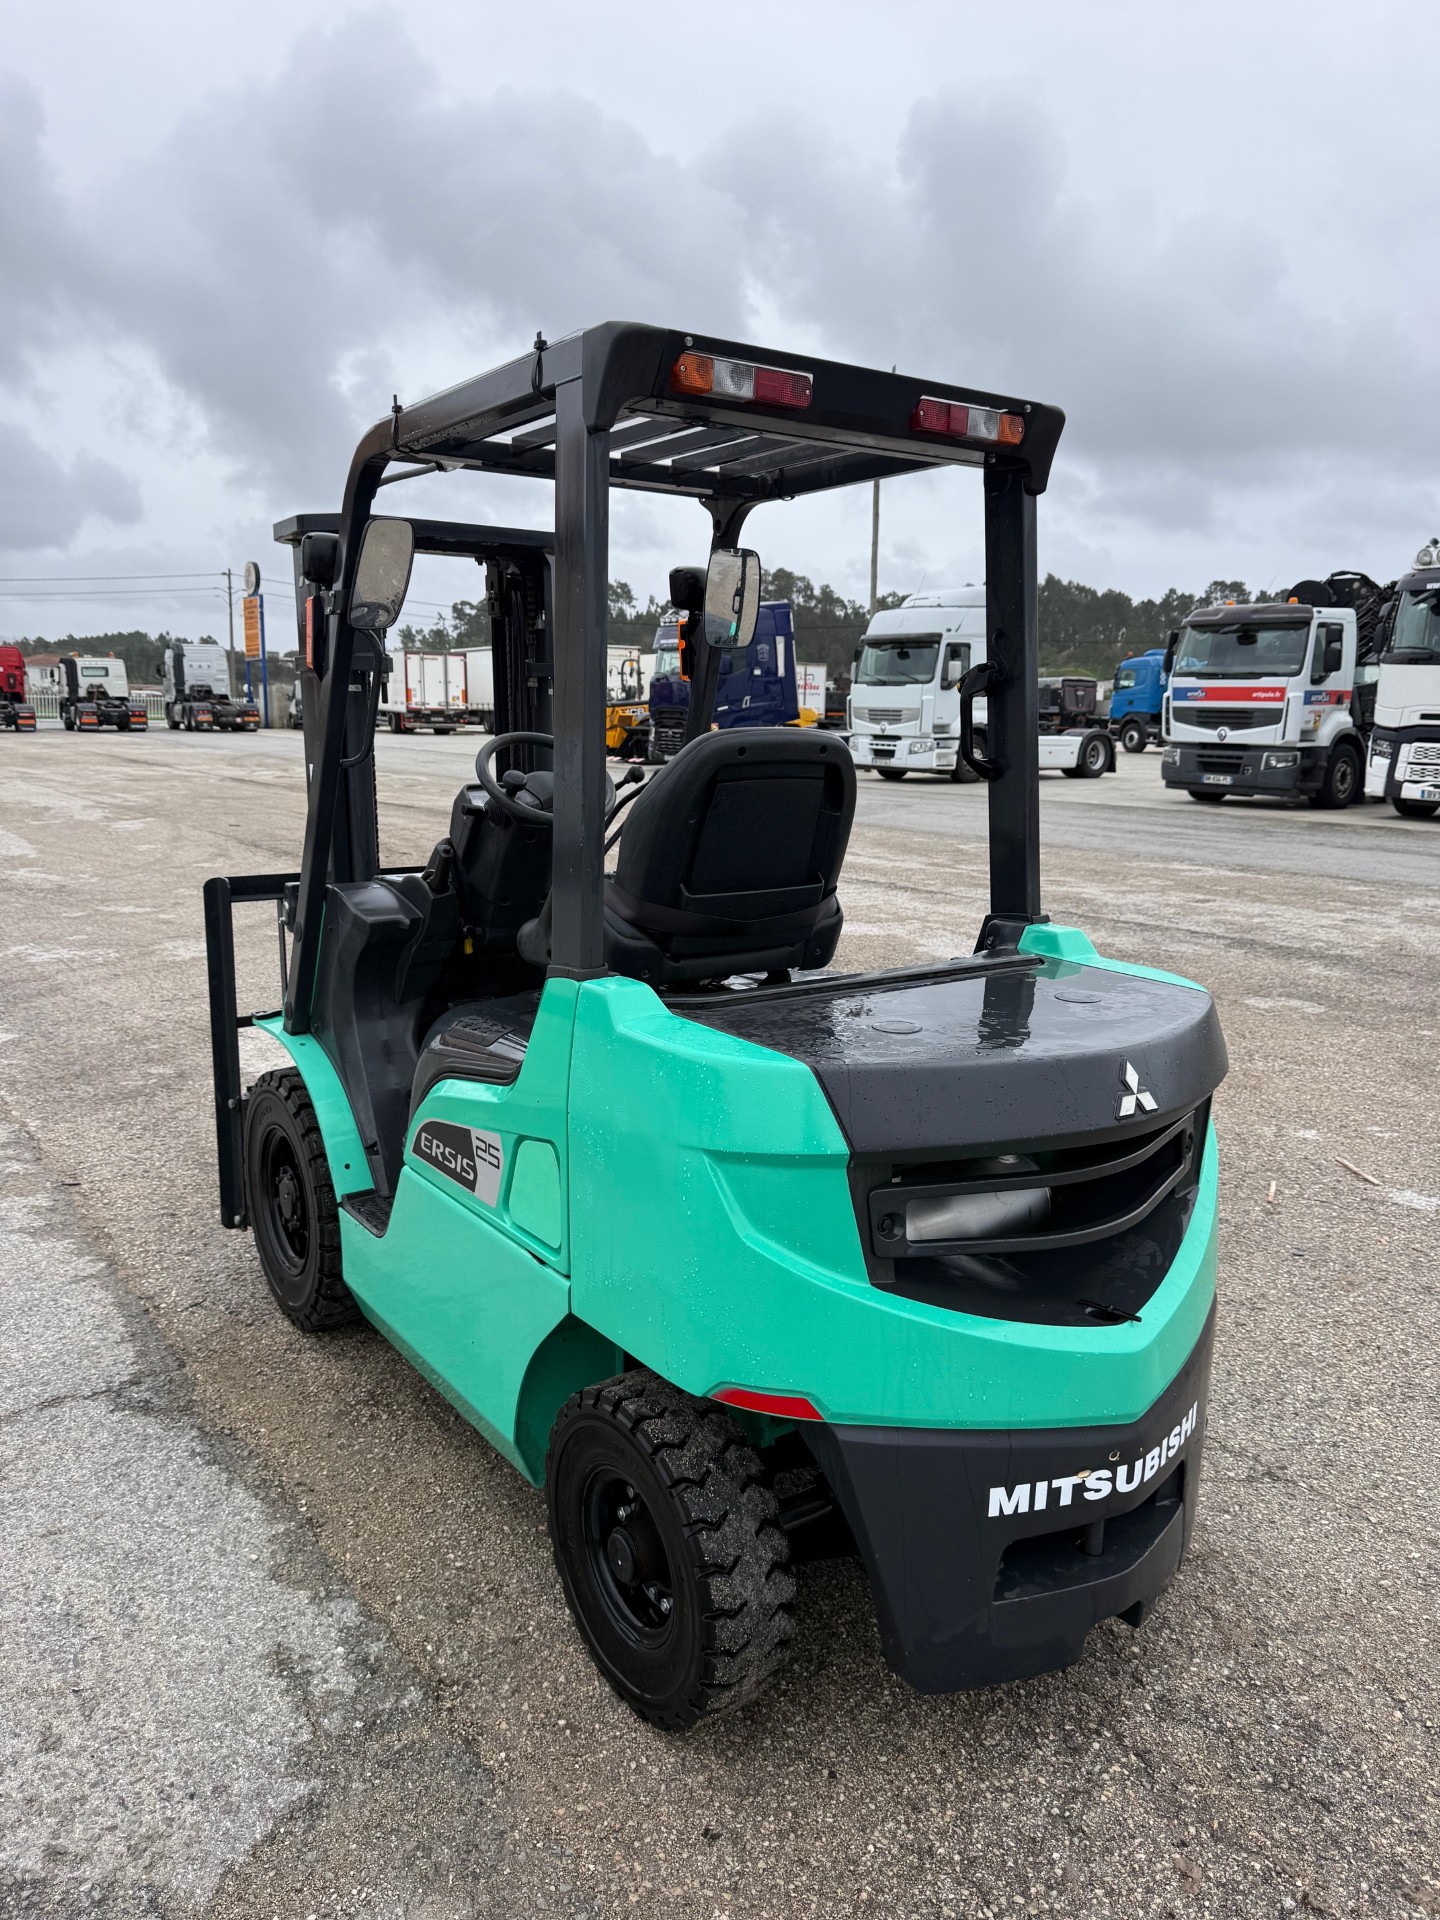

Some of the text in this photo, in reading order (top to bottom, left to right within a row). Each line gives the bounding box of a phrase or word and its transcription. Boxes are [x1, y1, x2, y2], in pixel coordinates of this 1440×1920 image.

[420, 1132, 500, 1181] ERSIS 25
[987, 1400, 1198, 1518] MITSUBISHI
